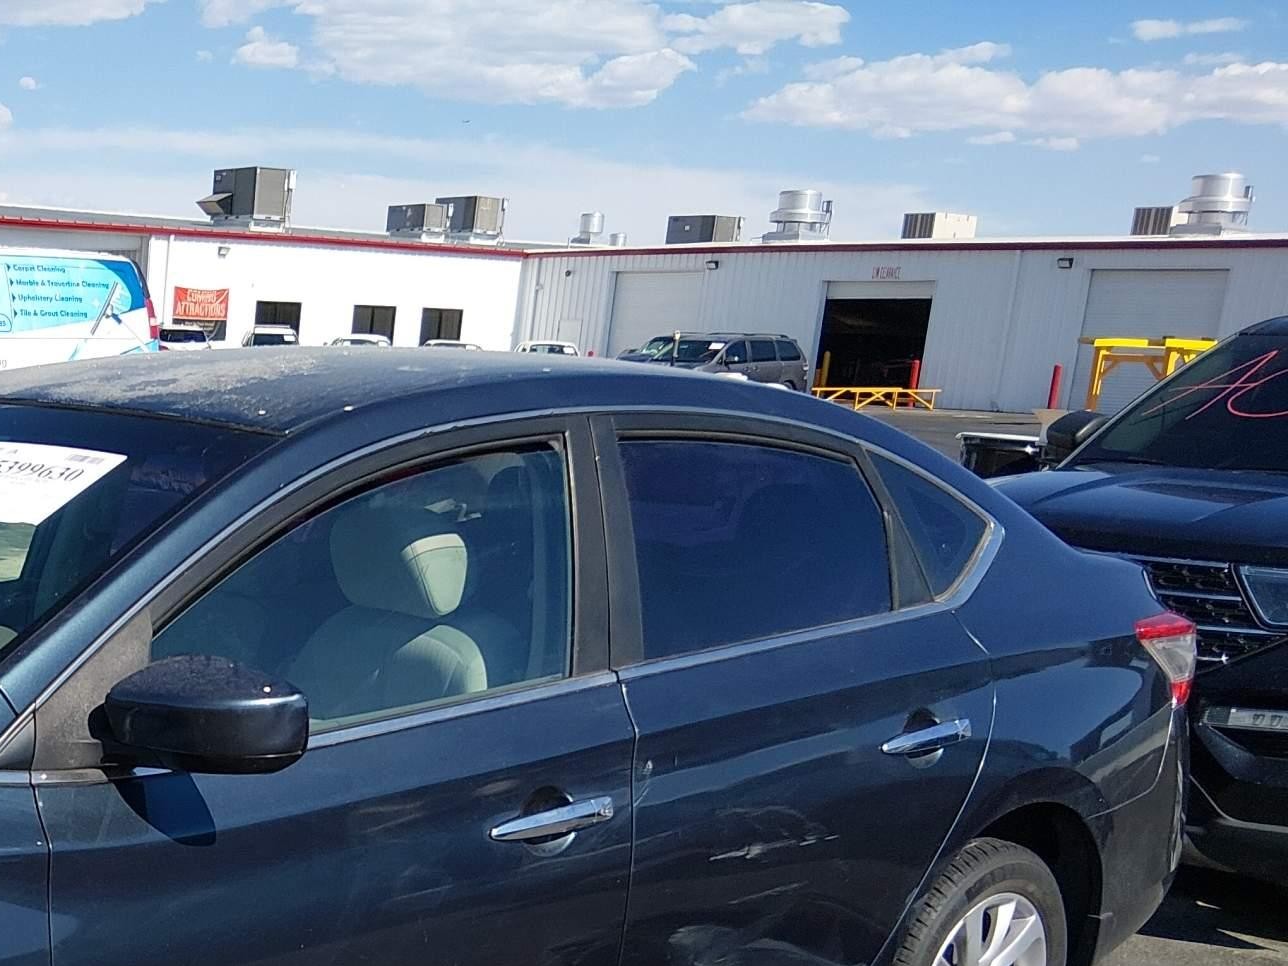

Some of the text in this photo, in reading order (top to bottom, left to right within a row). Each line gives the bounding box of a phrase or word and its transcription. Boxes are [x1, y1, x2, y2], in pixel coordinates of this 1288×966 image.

[13, 264, 66, 274] Carpet Cleaning
[16, 279, 39, 288] Marble
[40, 279, 46, 288] &
[81, 280, 110, 290] Cleaning
[55, 295, 83, 304] Cleaning
[20, 308, 88, 319] Tile & Grout Cleaning
[175, 301, 226, 318] ATTRACTIONS
